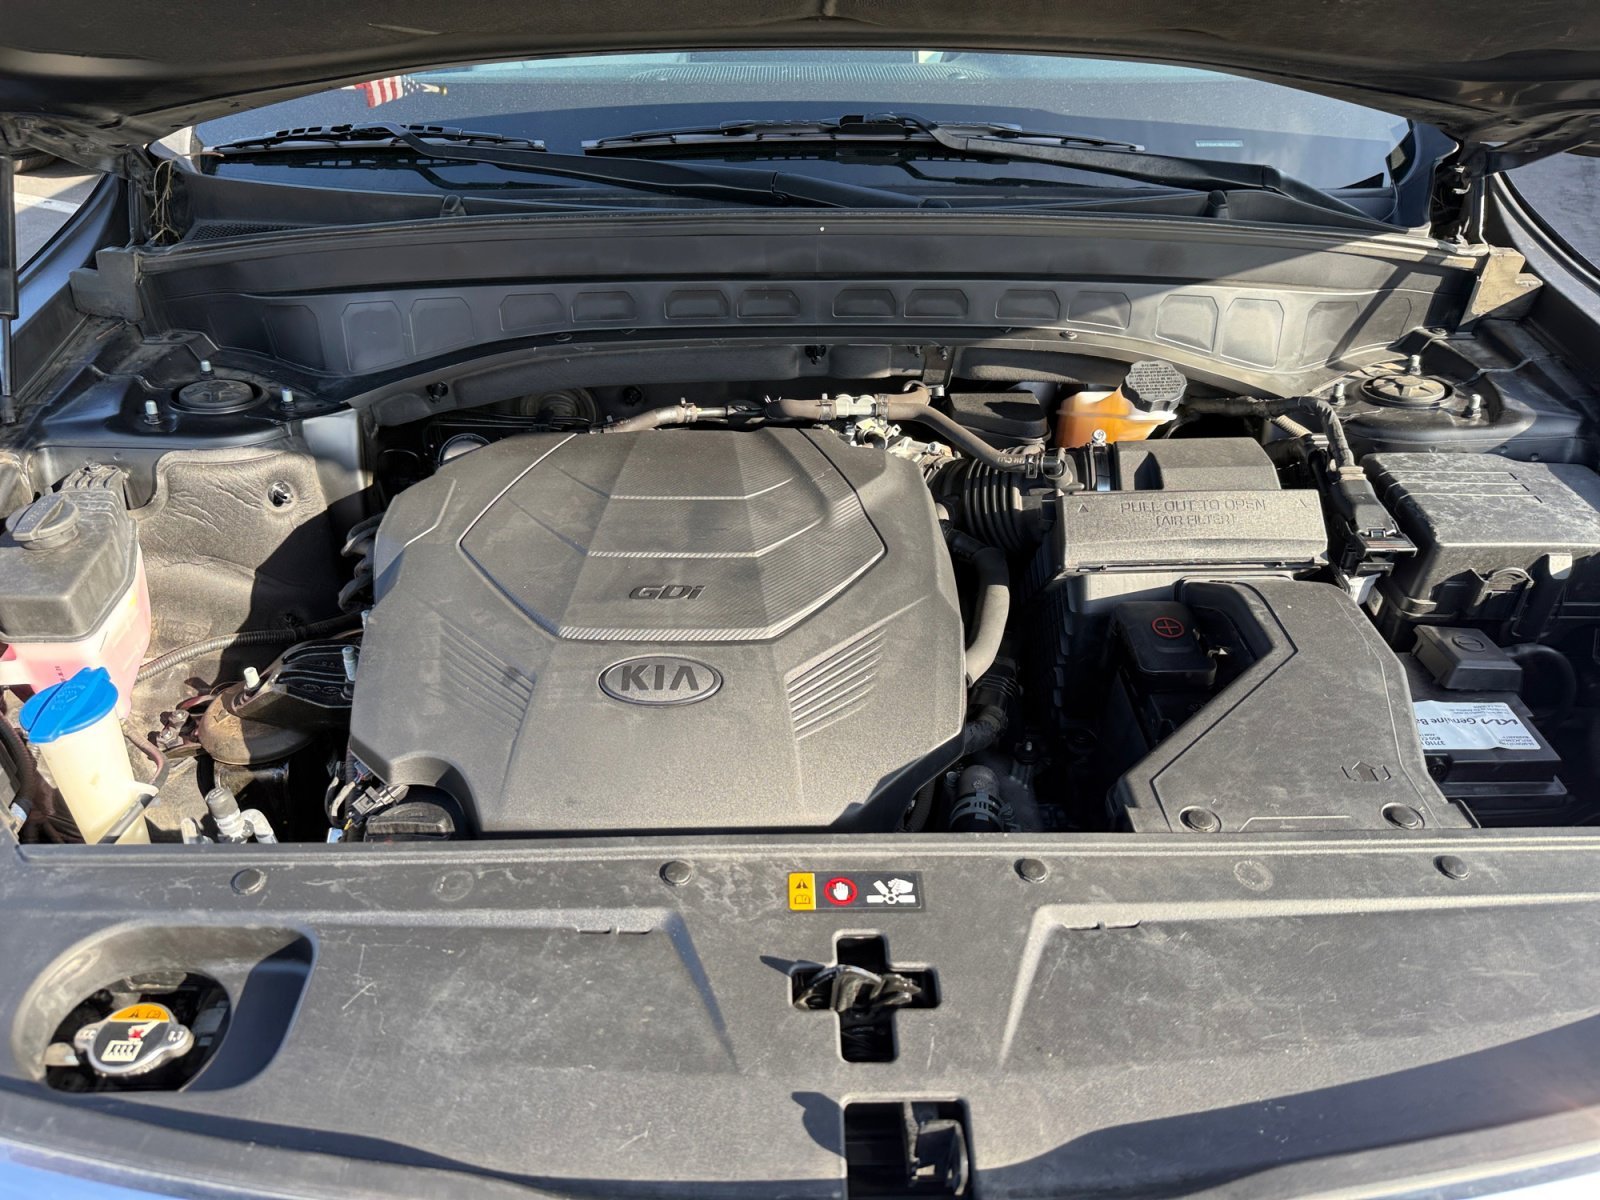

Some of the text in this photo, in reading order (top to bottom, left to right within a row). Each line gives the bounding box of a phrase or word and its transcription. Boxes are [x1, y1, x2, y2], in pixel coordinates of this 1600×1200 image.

[1120, 499, 1266, 514] PULL OUT TO OPEN
[629, 584, 706, 600] GDi
[620, 664, 700, 692] KIA
[1431, 717, 1476, 725] Genuine
